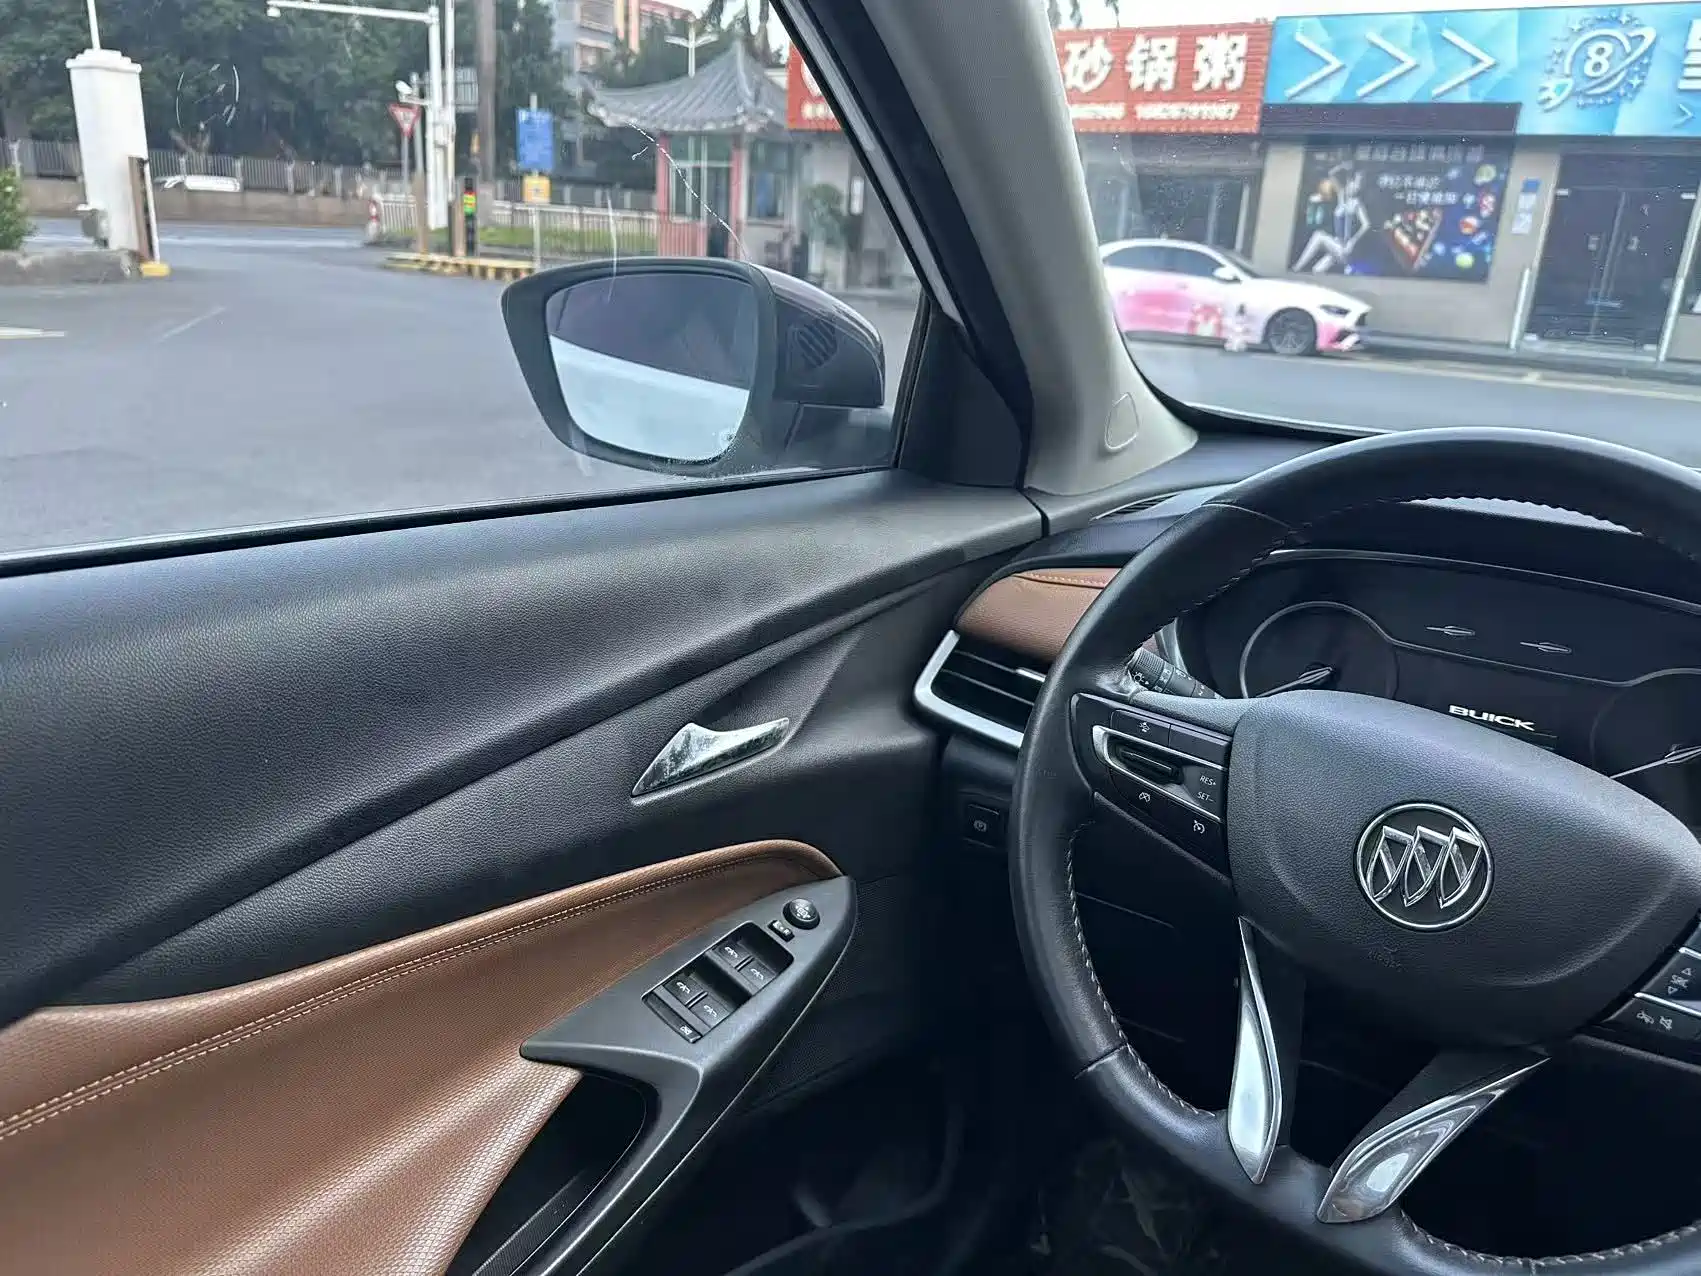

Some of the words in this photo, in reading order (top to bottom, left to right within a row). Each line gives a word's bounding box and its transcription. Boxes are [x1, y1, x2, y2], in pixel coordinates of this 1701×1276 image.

[1063, 33, 1249, 93] 砂锅粥
[1584, 41, 1614, 78] 8
[1448, 704, 1535, 732] BUICK
